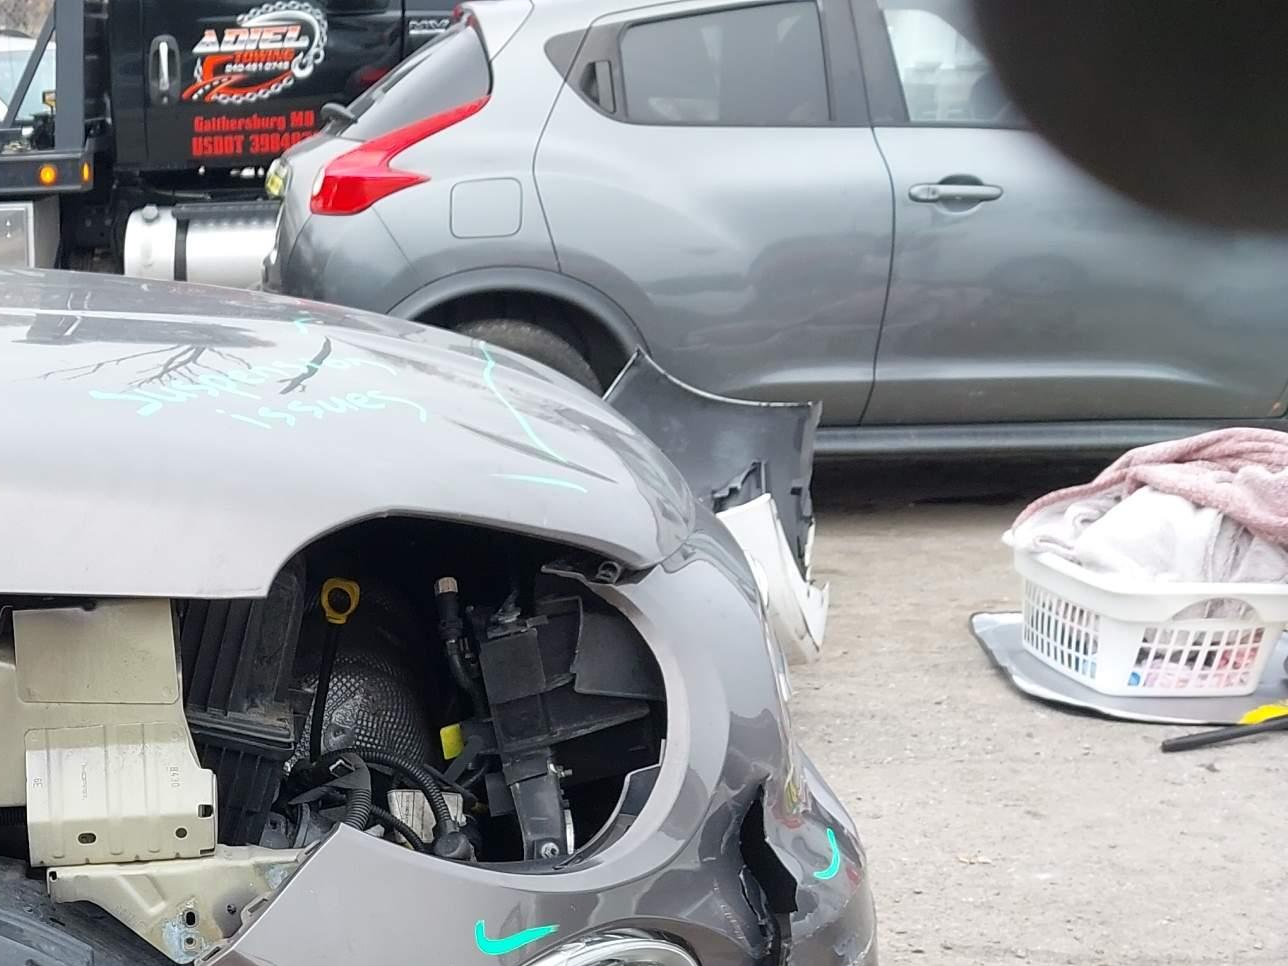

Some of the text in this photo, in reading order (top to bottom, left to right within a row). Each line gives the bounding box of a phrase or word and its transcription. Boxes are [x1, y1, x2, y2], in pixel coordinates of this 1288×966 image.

[192, 25, 310, 53] ADIEL
[233, 48, 296, 64] TOWING
[193, 110, 315, 132] Gaithersburg MD
[192, 135, 244, 156] USDOT
